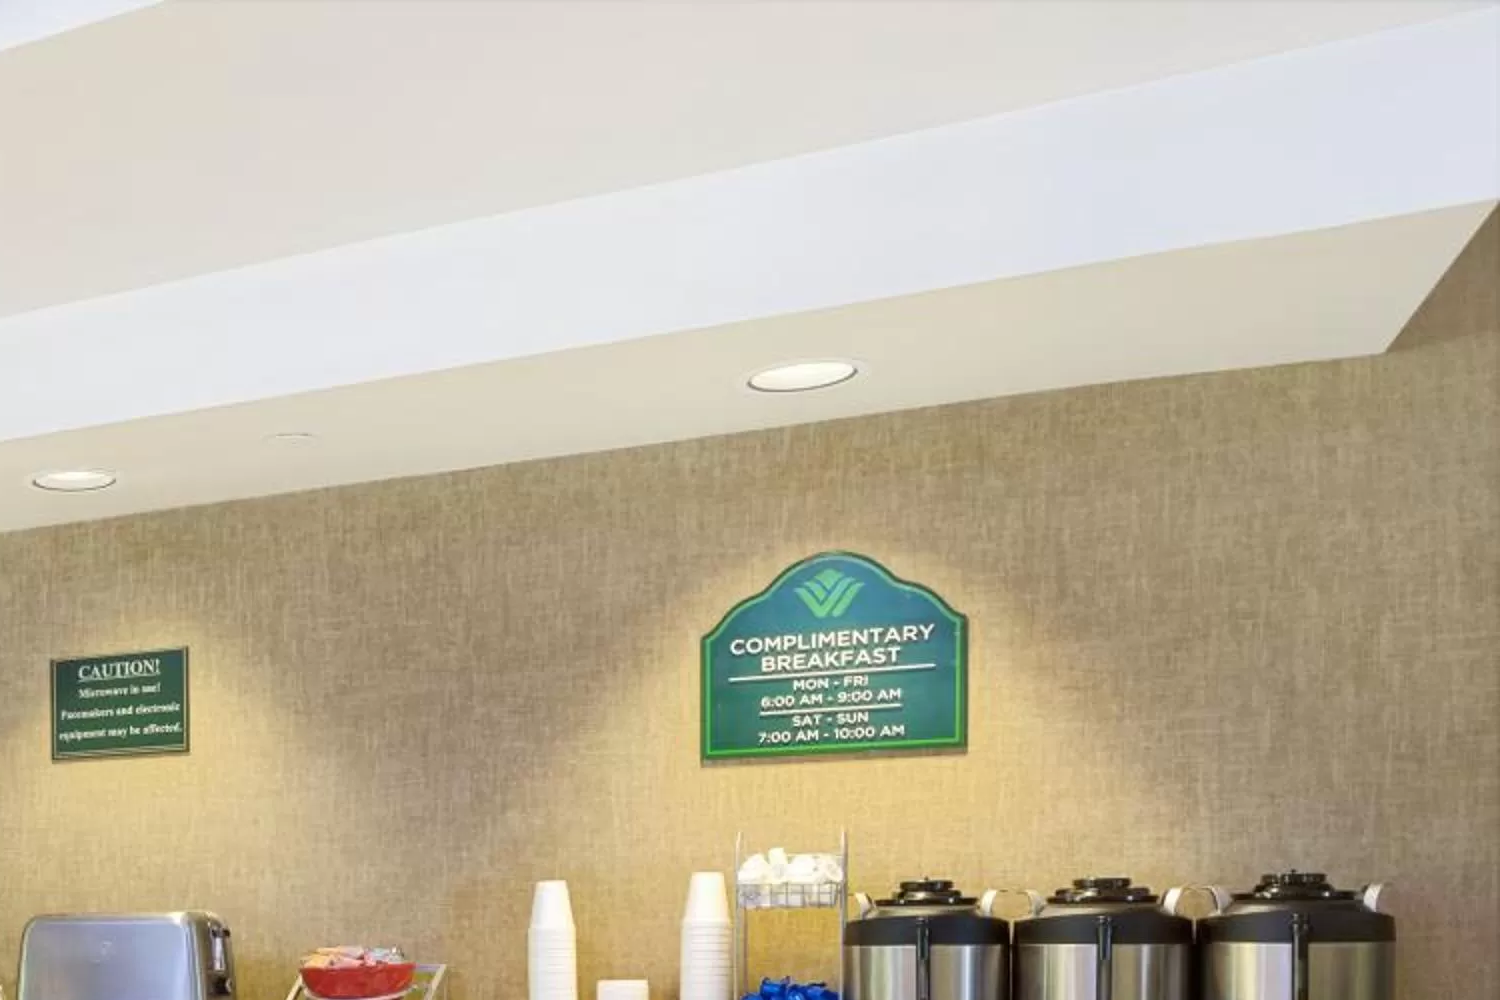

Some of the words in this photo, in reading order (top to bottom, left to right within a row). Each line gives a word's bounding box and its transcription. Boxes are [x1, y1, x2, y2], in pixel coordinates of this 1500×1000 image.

[730, 623, 935, 655] COMPLIMENTARY
[78, 658, 161, 681] CAUTION!
[761, 647, 901, 673] BREAKFAST
[793, 677, 829, 691] MON
[843, 675, 869, 688] FRI
[761, 696, 795, 709] 6:00
[800, 693, 823, 705] AM
[837, 690, 873, 703] 9:00
[877, 688, 902, 700] AM
[792, 715, 822, 728] SAT
[837, 712, 869, 724] SUN
[758, 731, 792, 743] 7:00
[795, 729, 819, 741] AM
[834, 726, 875, 739] 10:00
[879, 724, 905, 736] AM
